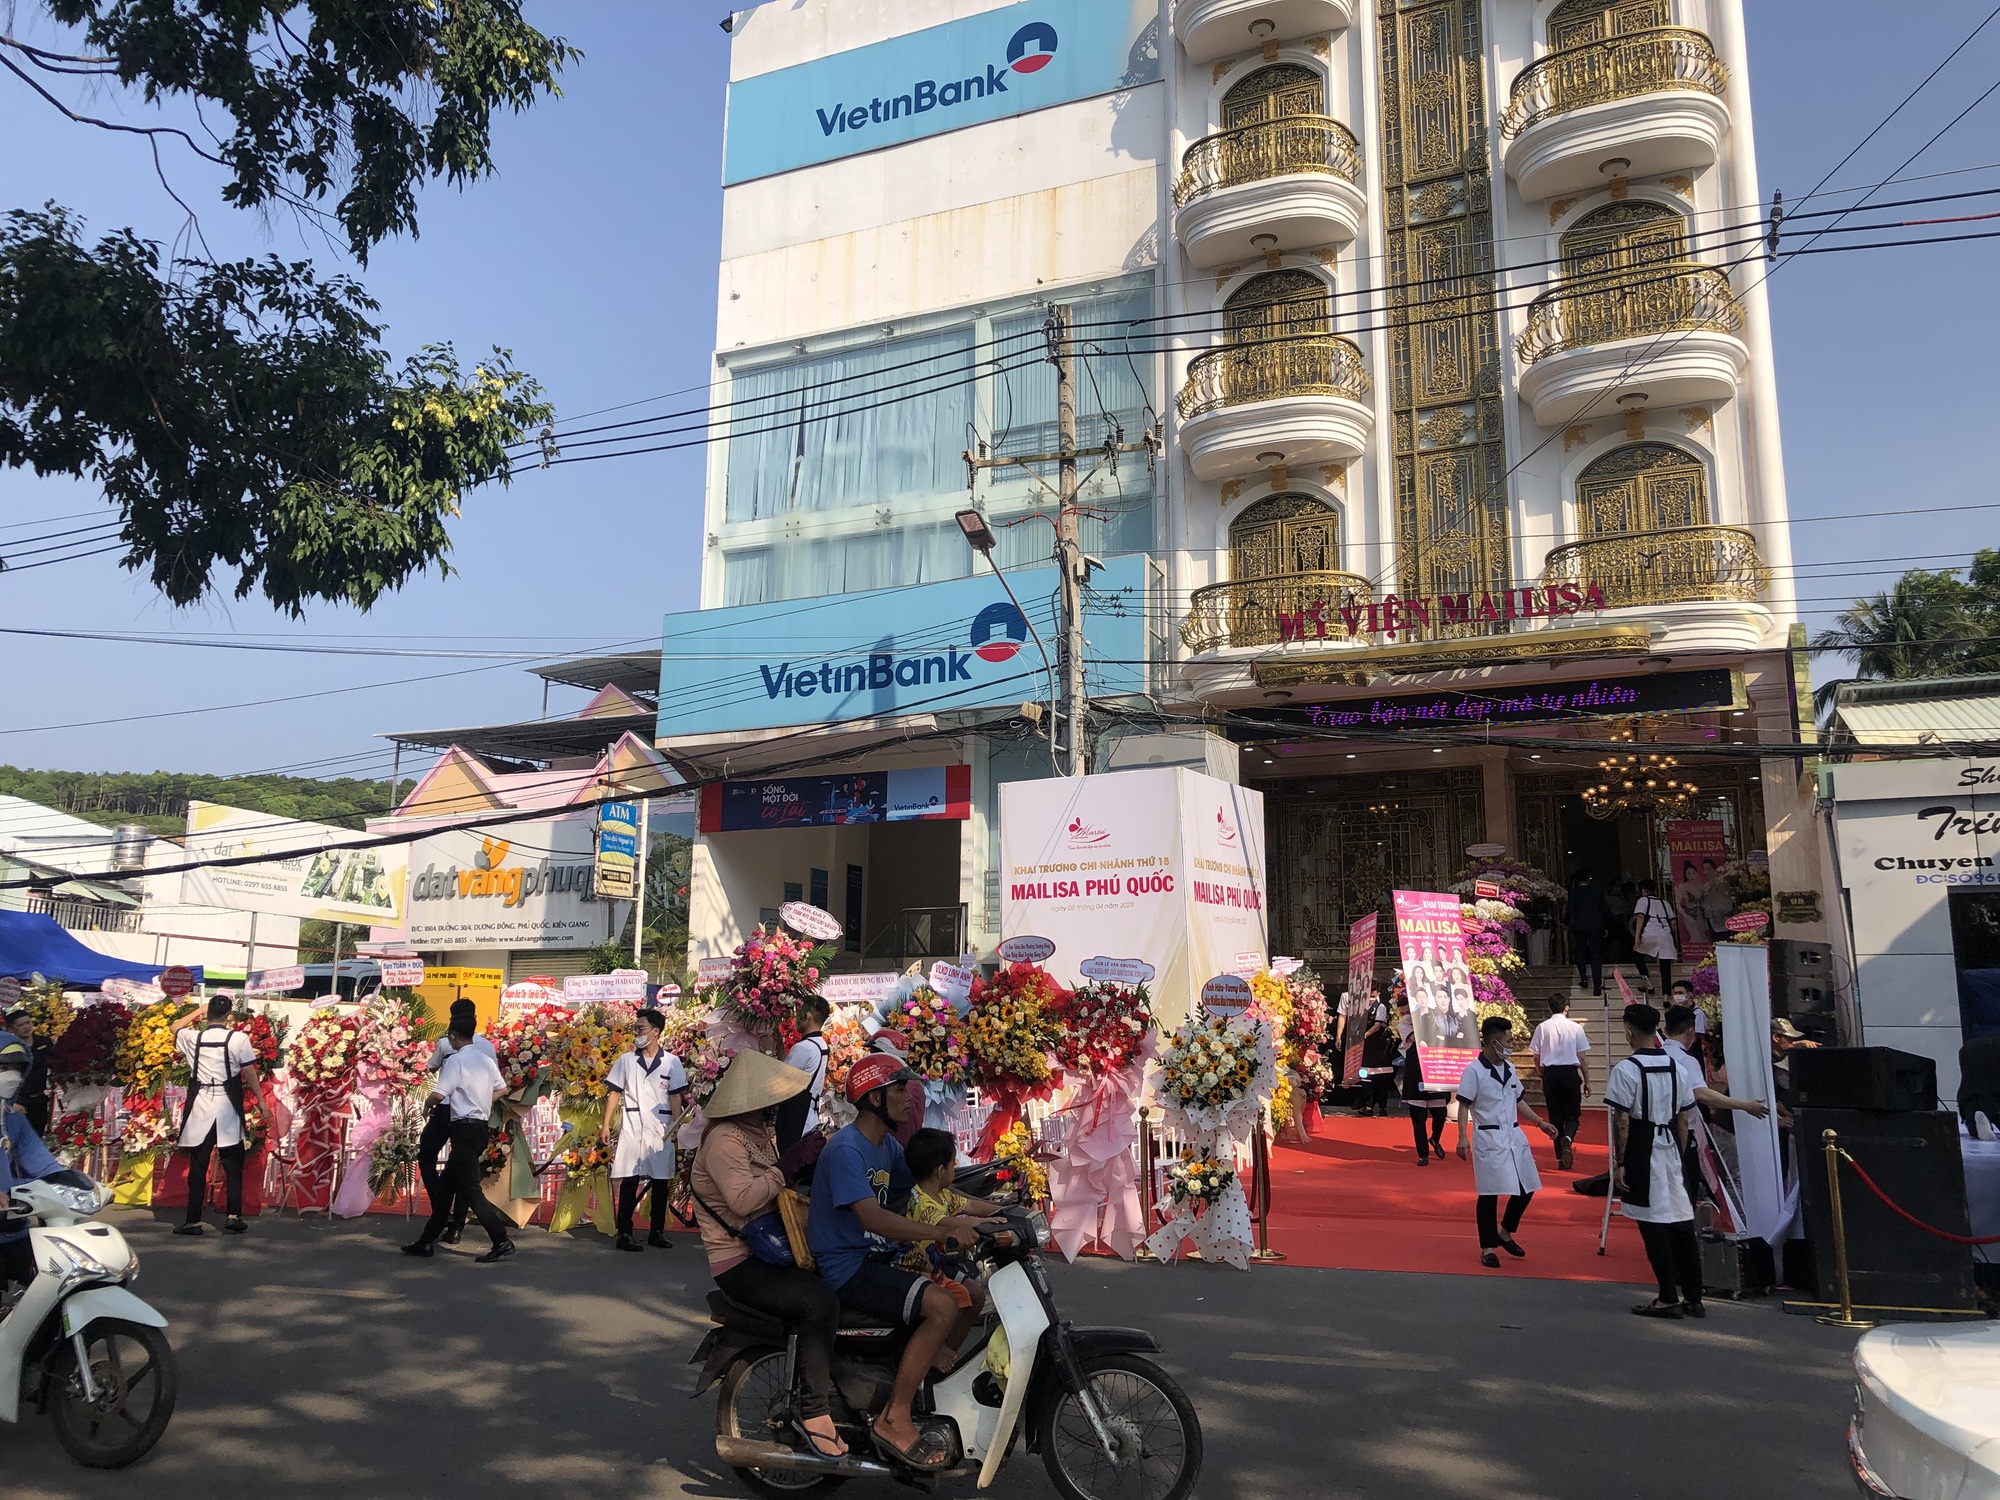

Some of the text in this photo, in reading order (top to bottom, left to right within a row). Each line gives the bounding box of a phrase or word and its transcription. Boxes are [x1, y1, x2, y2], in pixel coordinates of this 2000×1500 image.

[816, 63, 1009, 137] VietinBank
[1278, 580, 1609, 642] MỸ VIỆN MAILISA
[759, 644, 972, 700] VietinBank
[762, 783, 786, 795] SỐNG
[762, 791, 799, 805] MỘT ĐỜI
[609, 804, 630, 821] ATM
[1671, 840, 1724, 851] MAILISA
[1014, 855, 1170, 875] KHAI TRƯƠNG CHI NHÁNH THỨ 15
[1874, 856, 1994, 871] Chuyen
[212, 877, 288, 892] HOTLINE: 0297 655 8855
[1011, 869, 1175, 901] MAILISA PHÚ QUỐC
[1194, 880, 1262, 912] MAILISA PHÚ QUỐC
[1119, 901, 1134, 909] 2023
[437, 921, 459, 932] ĐƯỜNG
[517, 919, 530, 930] PHÚ
[531, 918, 551, 930] QUỐC,
[552, 919, 567, 929] KIÊN
[568, 920, 590, 929] GIANG
[1399, 918, 1462, 935] MAILISA
[410, 937, 430, 945] Hotline:
[430, 937, 443, 945] 0297
[444, 936, 454, 944] 655
[454, 936, 467, 944] 8855
[499, 935, 574, 944] www.datvangphuquoc.com
[960, 971, 972, 983] ANH
[504, 1001, 541, 1010] CHÚC MỪNG
